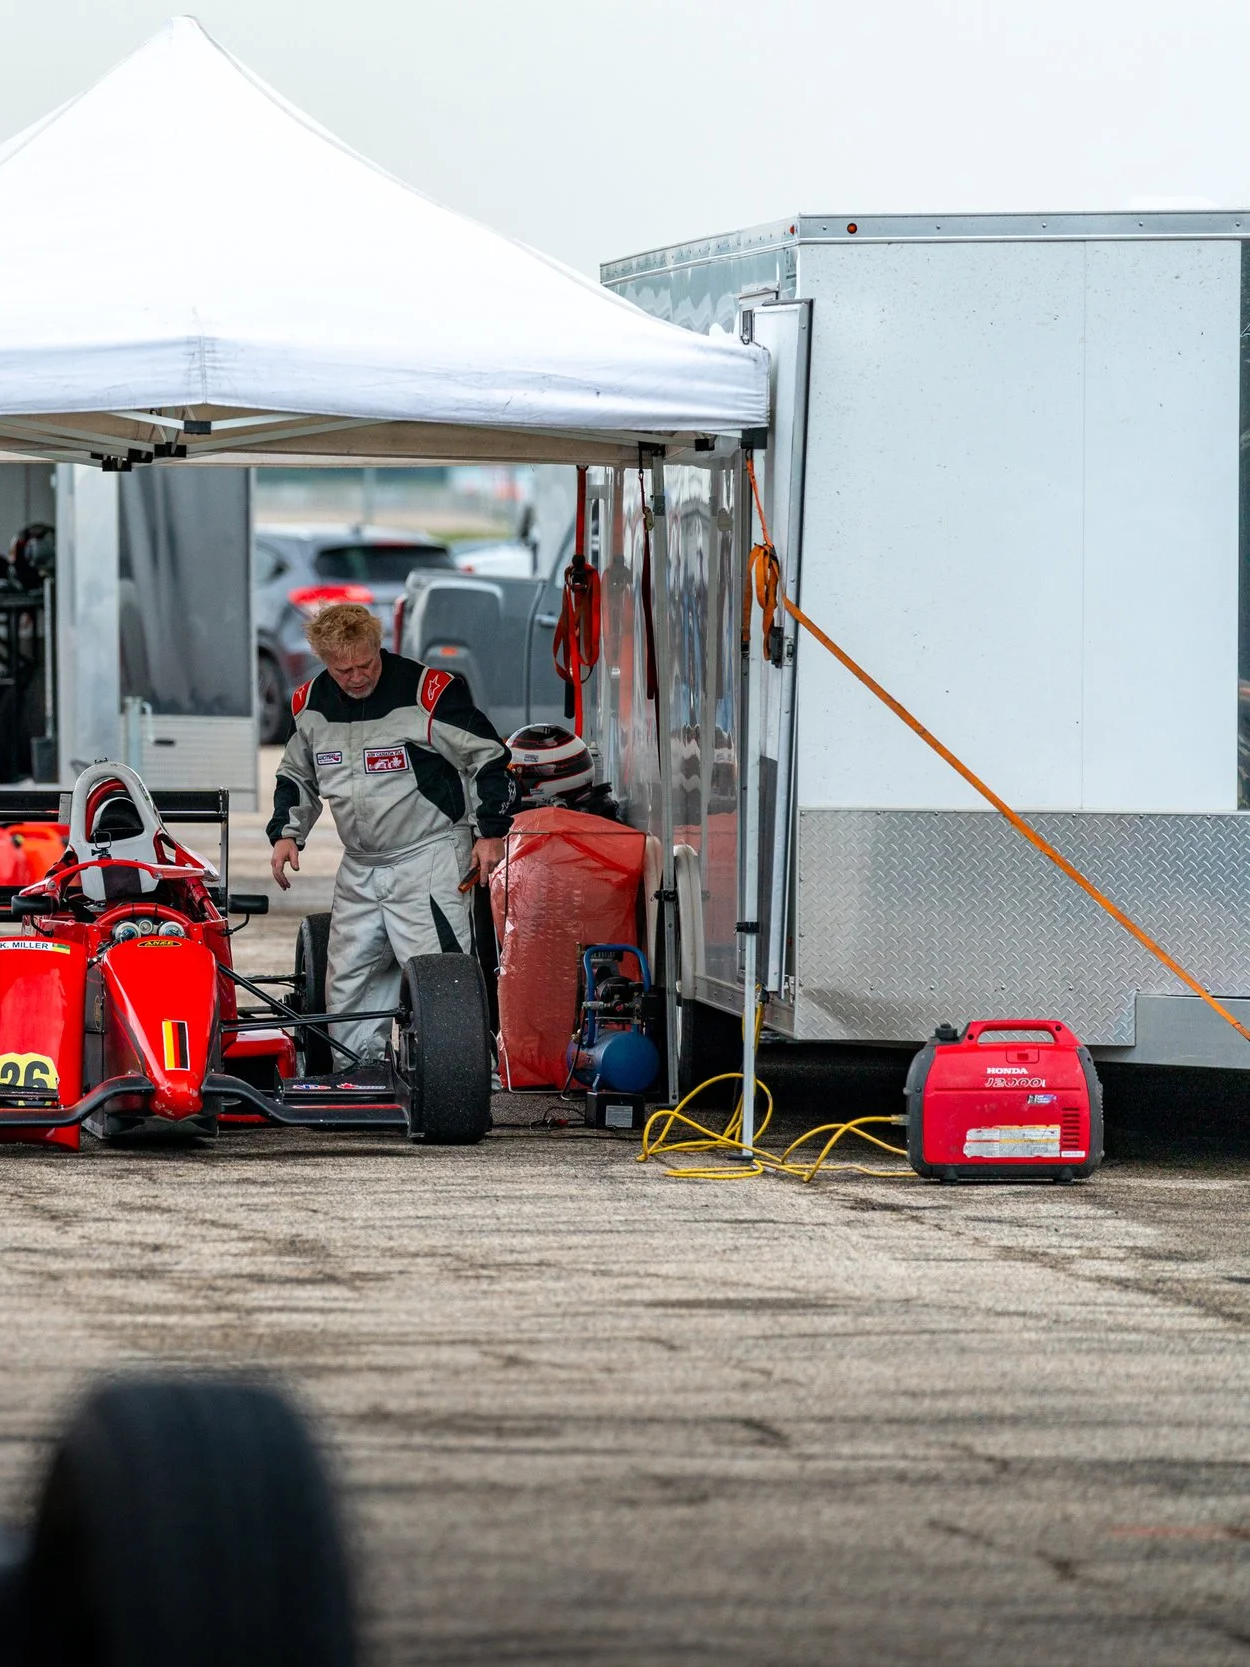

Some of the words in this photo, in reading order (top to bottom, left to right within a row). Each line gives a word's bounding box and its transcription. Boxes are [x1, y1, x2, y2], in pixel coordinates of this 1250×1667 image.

[12, 942, 49, 950] MILLER
[986, 1067, 1029, 1075] HONDA
[0, 1060, 50, 1106] 26
